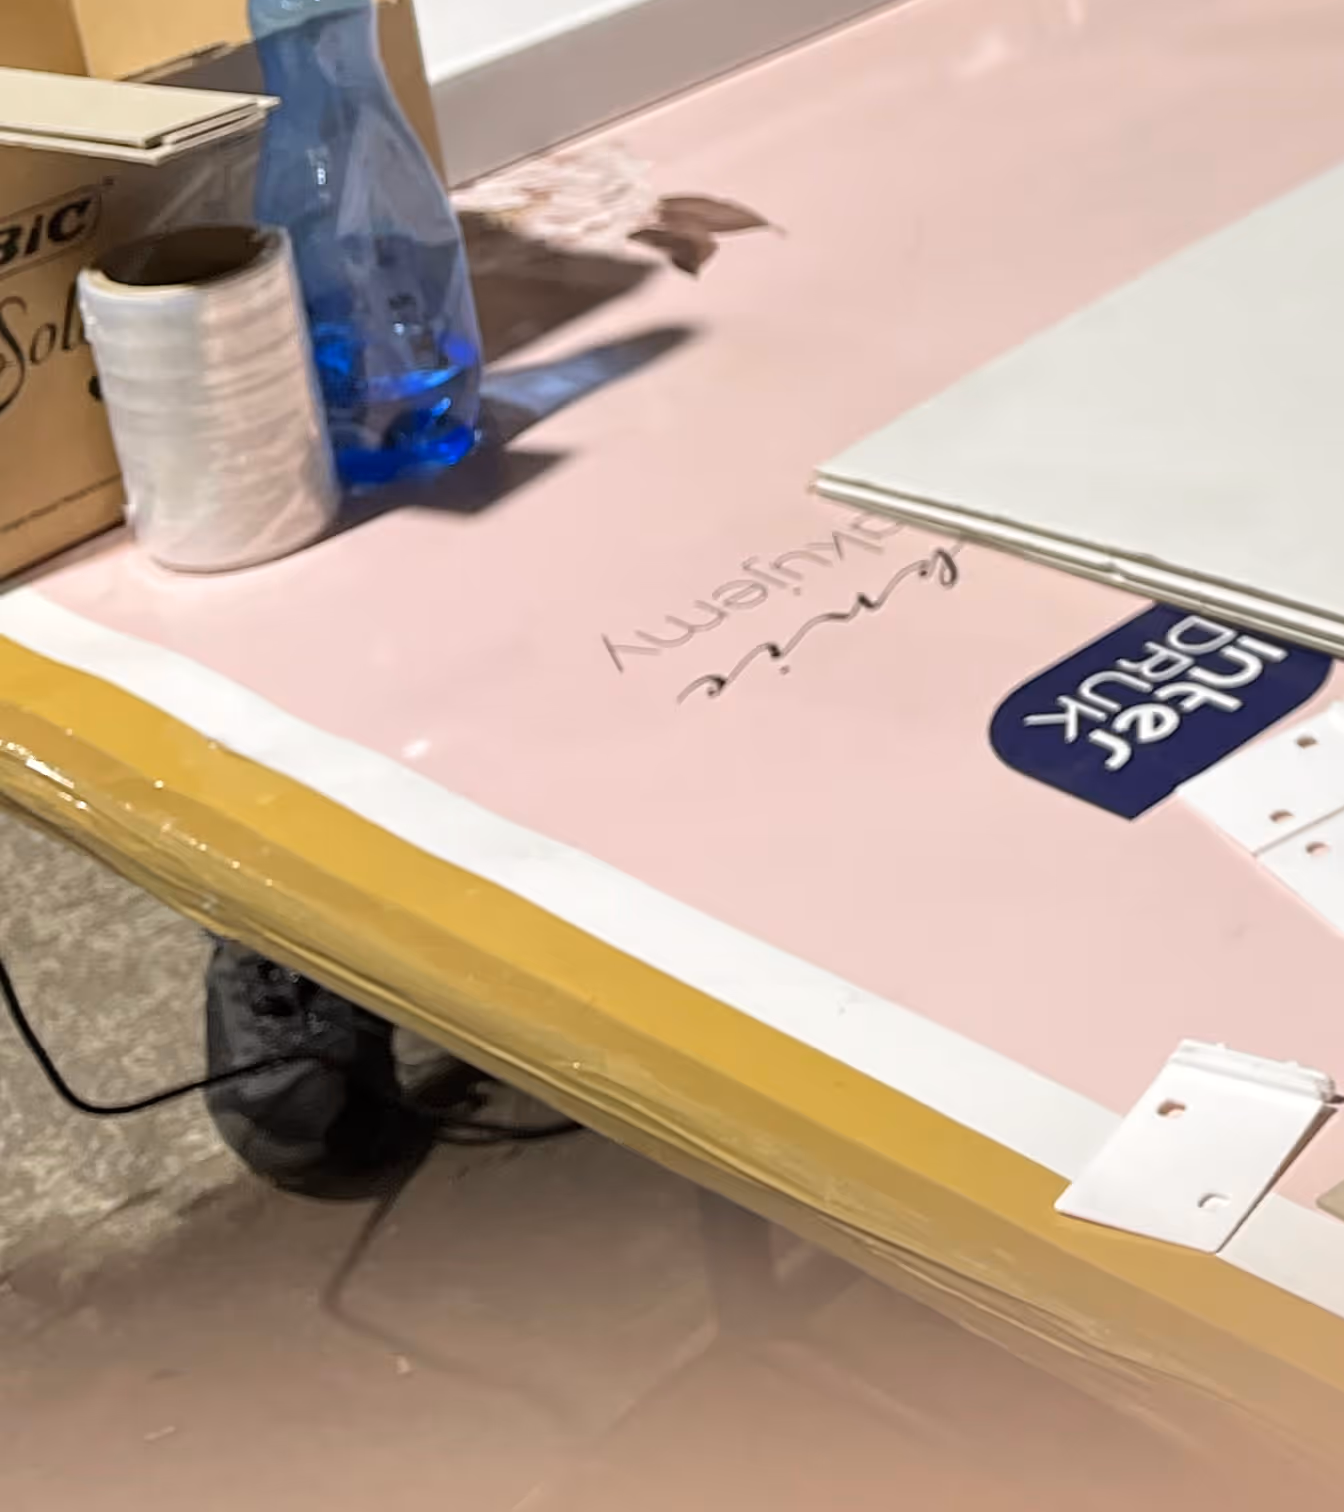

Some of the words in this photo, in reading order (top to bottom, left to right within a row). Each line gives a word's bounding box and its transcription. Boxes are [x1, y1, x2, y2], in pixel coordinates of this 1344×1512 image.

[0, 199, 92, 265] BIC
[0, 281, 90, 414] Sol
[1023, 614, 1238, 744] DRUK
